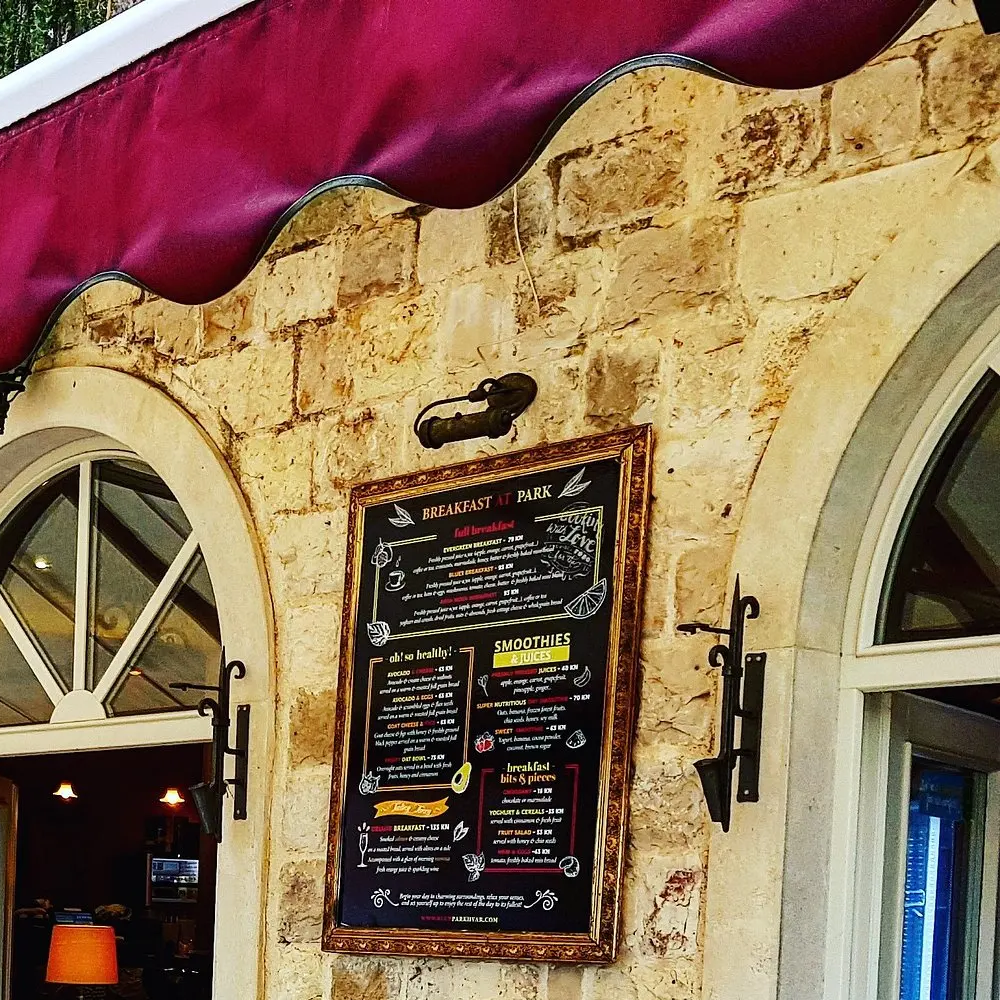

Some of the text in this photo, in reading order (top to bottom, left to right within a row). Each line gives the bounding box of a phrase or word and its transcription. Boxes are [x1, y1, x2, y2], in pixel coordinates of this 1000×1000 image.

[421, 484, 553, 521] BREAKFAST AT PARK
[453, 519, 516, 538] full breakfast
[558, 524, 597, 553] Love
[494, 632, 572, 652] SMOOTHIES
[389, 645, 453, 664] oh! so healthy!
[519, 650, 552, 665] JUICES
[387, 669, 411, 678] AVOCADO
[538, 667, 557, 675] JUICES
[392, 694, 416, 703] AVOCADO
[476, 701, 494, 709] SUPER
[494, 699, 528, 708] NUTRITIOUS
[507, 761, 550, 773] breakfast
[500, 772, 556, 786] bits & pieces
[520, 807, 545, 815] CEREALS
[393, 824, 426, 832] BREAKFAST
[514, 828, 532, 836] SALAD
